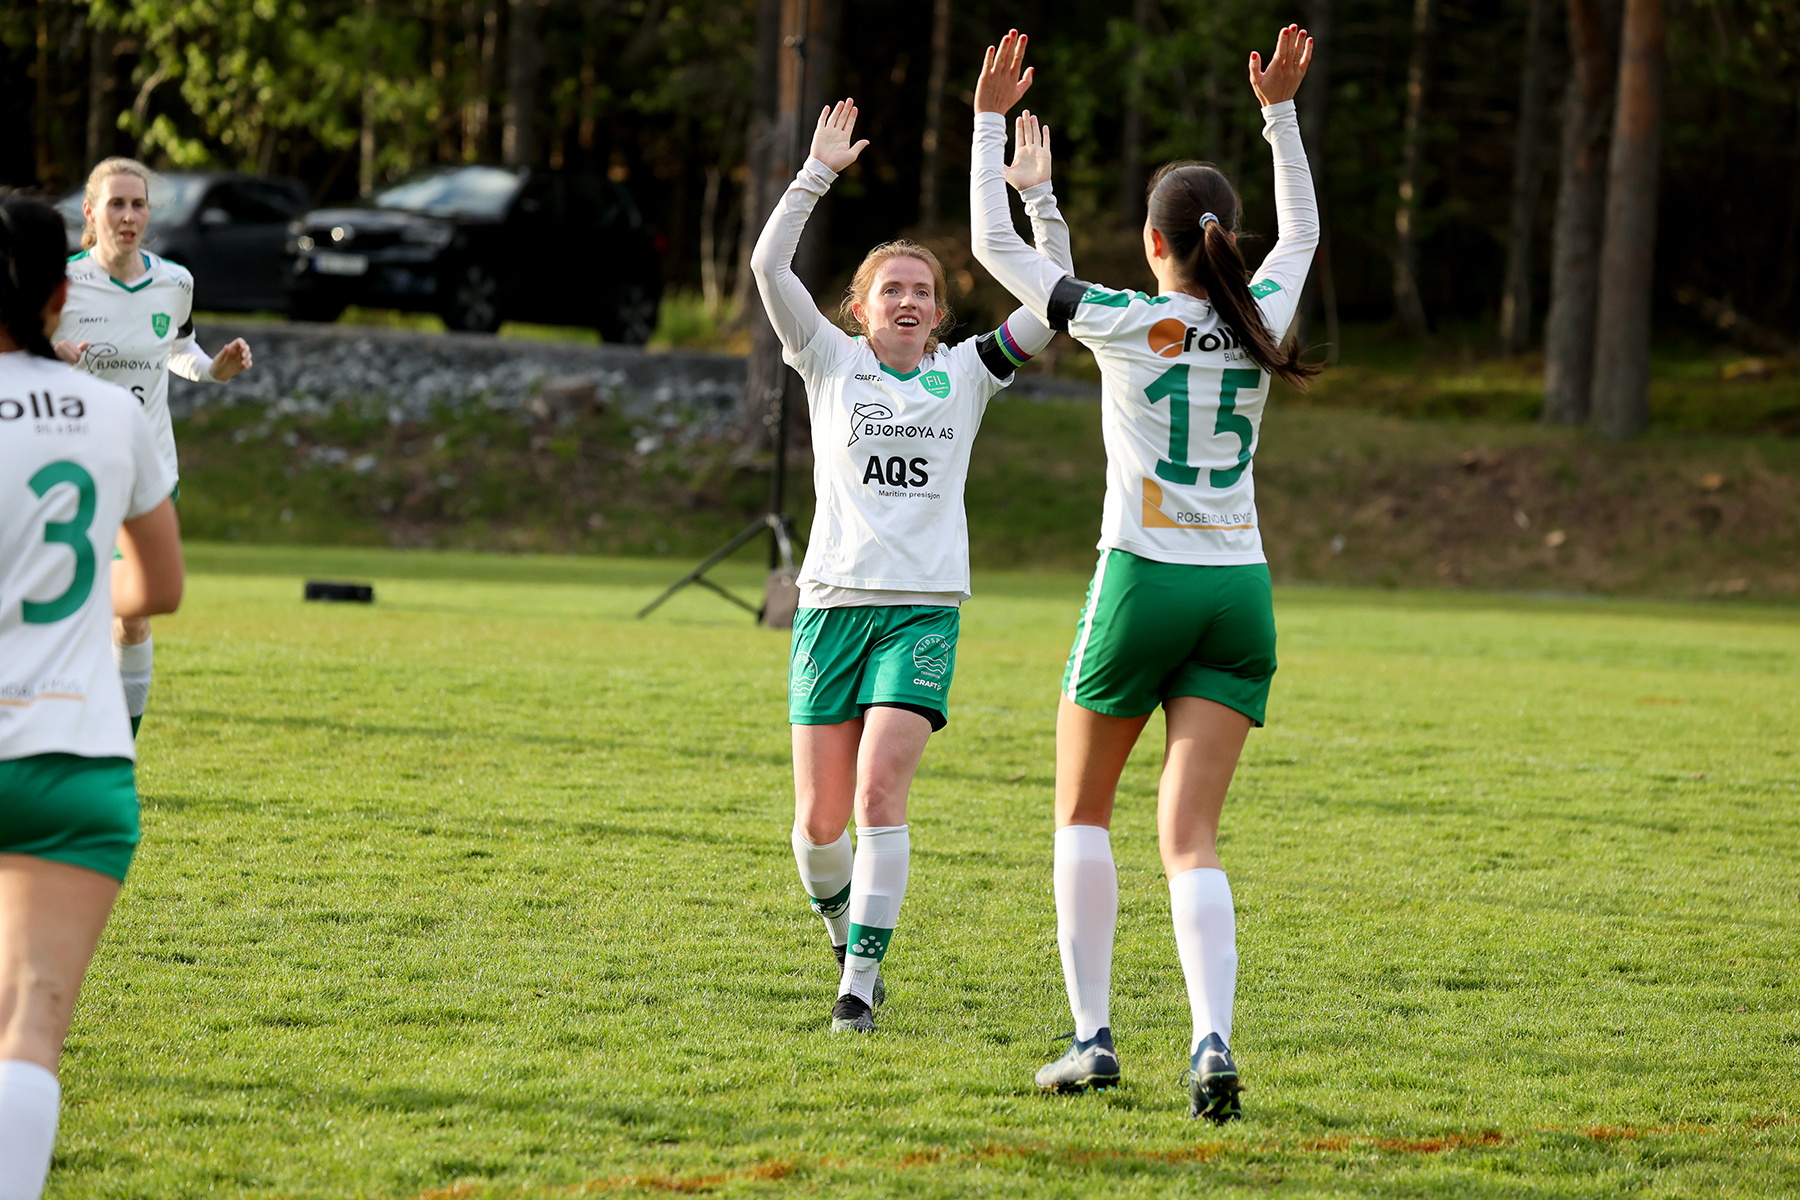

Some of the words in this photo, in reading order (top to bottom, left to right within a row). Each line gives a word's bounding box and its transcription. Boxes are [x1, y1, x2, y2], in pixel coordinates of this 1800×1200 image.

[155, 316, 168, 328] FIL
[1183, 327, 1241, 352] foll
[1224, 352, 1238, 362] BIL
[854, 373, 877, 382] CRAFT
[925, 374, 946, 387] FIL
[0, 390, 85, 421] olla
[864, 424, 935, 439] BJØRØYA
[939, 427, 954, 440] AS
[1143, 363, 1262, 489] 15
[862, 455, 929, 489] AQS
[878, 490, 908, 498] Maritim
[909, 491, 941, 500] presisjon
[1176, 511, 1232, 525] ROSENDAL
[22, 459, 97, 625] 3
[912, 678, 938, 689] CRAFT
